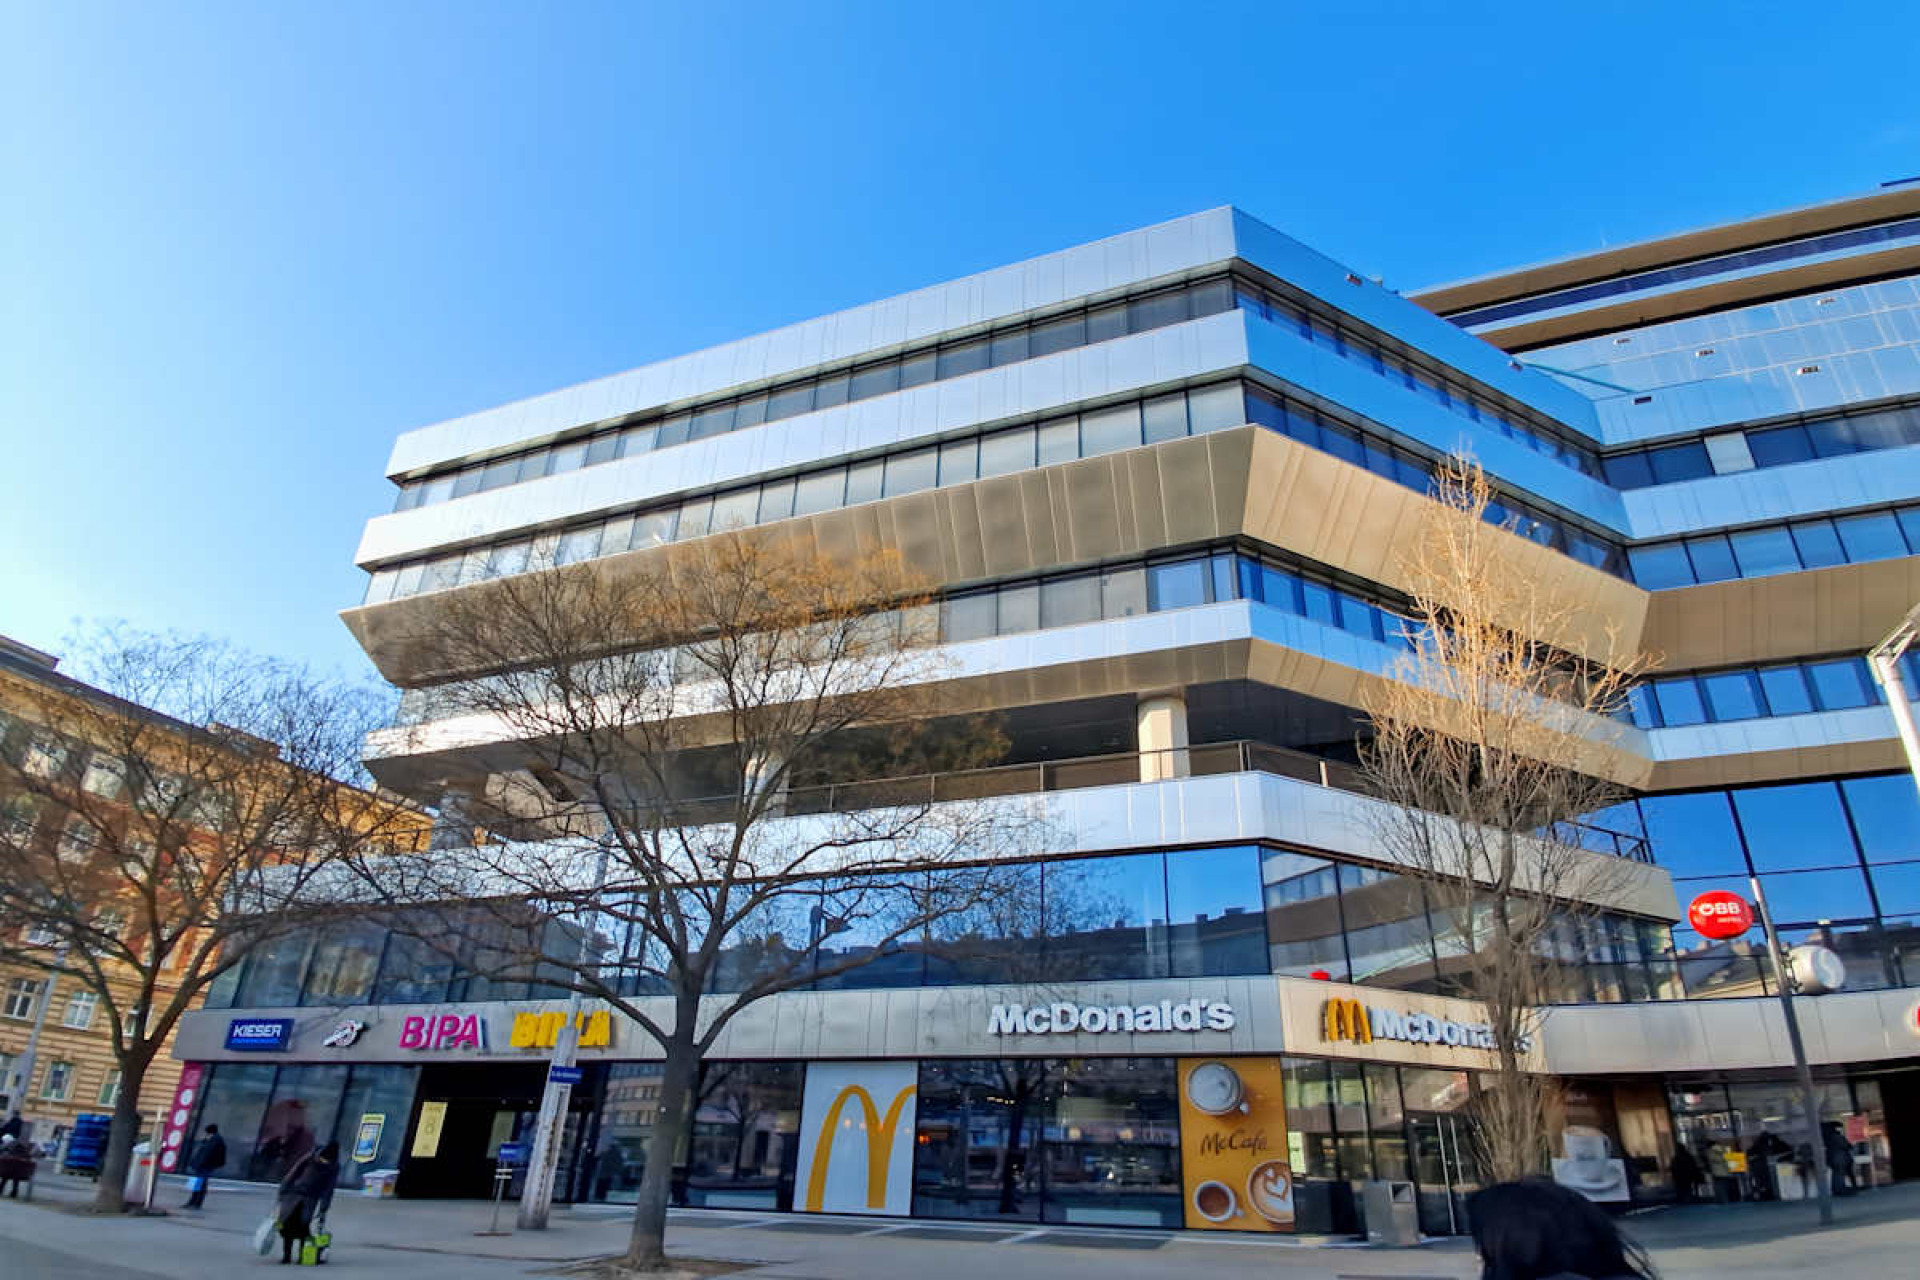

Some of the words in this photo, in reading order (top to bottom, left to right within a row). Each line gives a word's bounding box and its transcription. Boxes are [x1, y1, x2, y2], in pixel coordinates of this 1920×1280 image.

[232, 1024, 283, 1038] KIESER
[398, 1014, 481, 1050] BIPA
[988, 998, 1235, 1035] McDonald's
